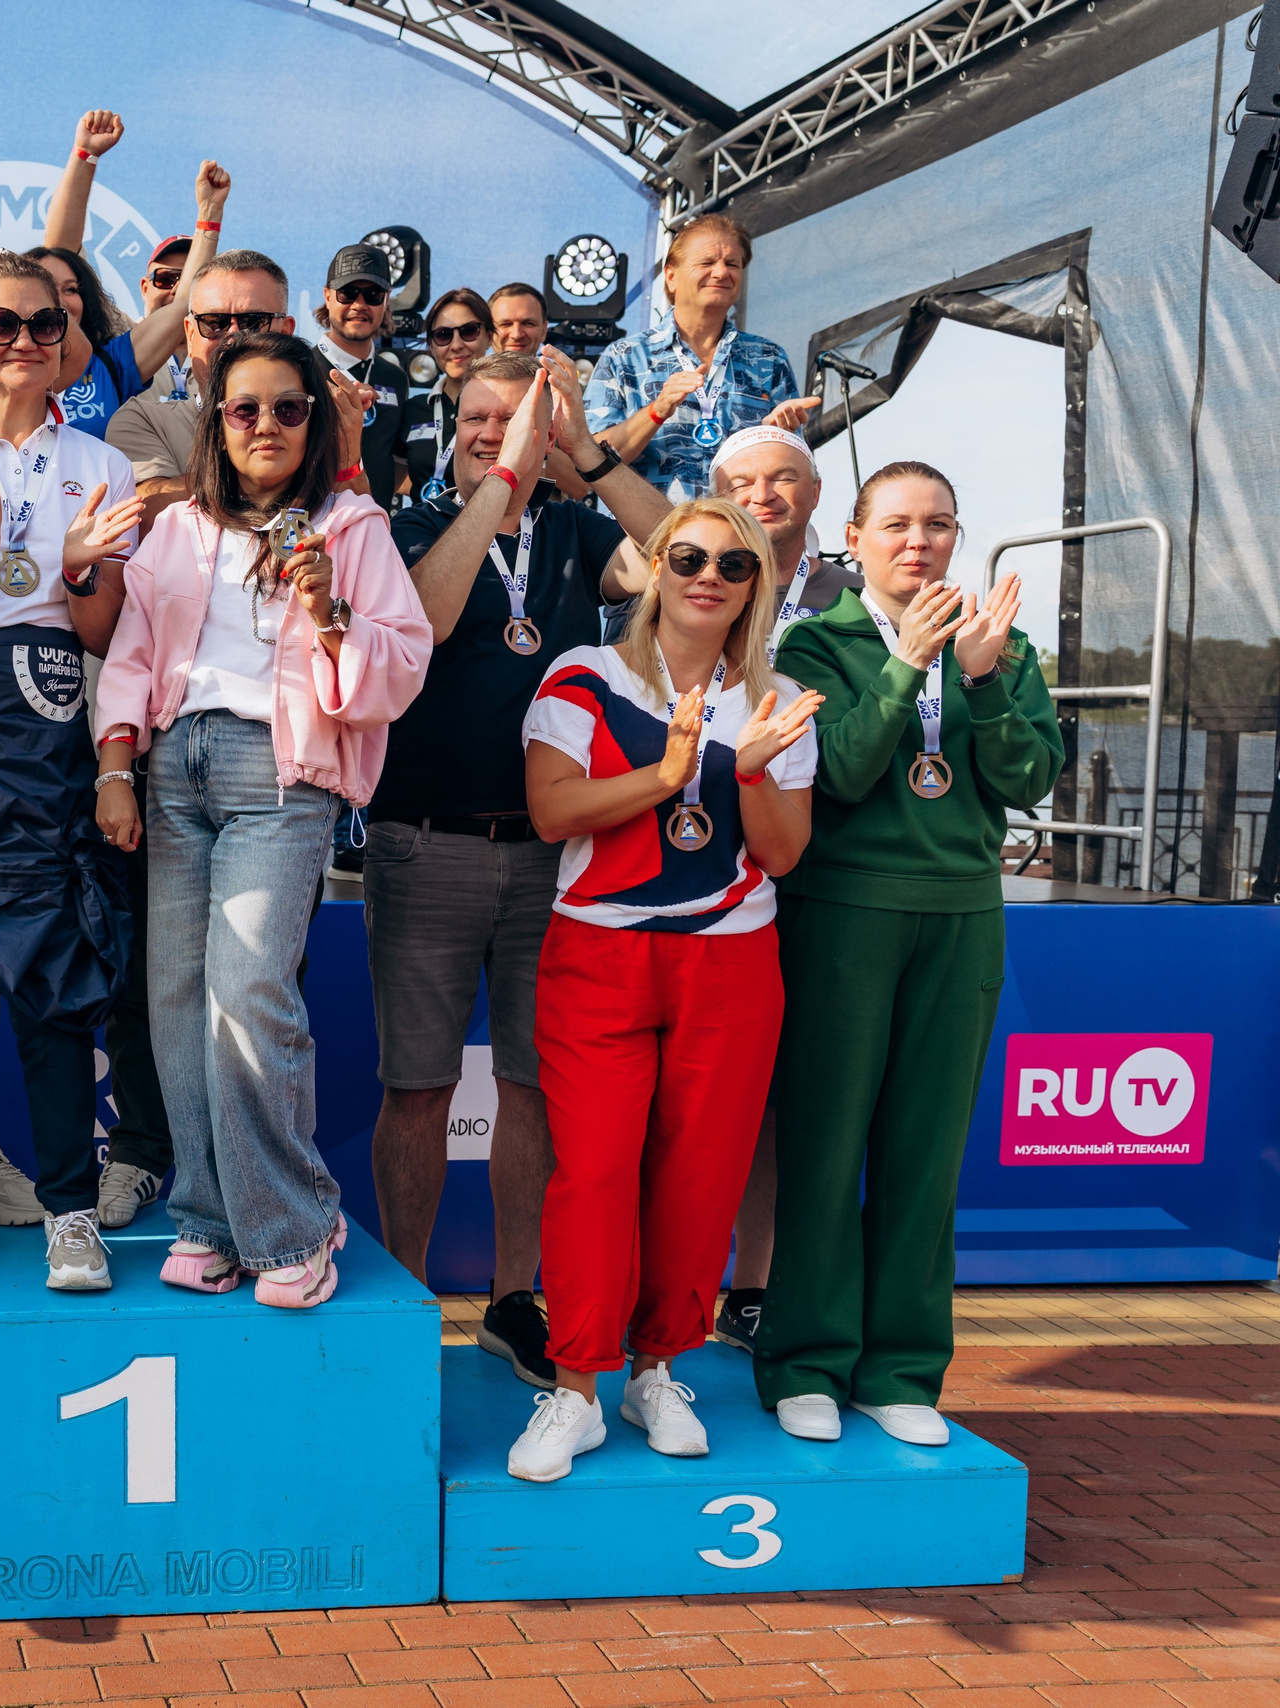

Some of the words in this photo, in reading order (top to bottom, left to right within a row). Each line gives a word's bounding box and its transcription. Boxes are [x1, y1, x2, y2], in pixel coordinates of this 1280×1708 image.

[1127, 1077, 1179, 1107] TV
[447, 1118, 490, 1136] ADIO
[1014, 1142, 1114, 1155] МУЗЫКАЛЬНЫЙ
[1116, 1143, 1190, 1154] ТЕЛЕКАНАЛ
[58, 1353, 179, 1506] 1
[697, 1492, 785, 1570] 3
[166, 1545, 366, 1597] MOBILI
